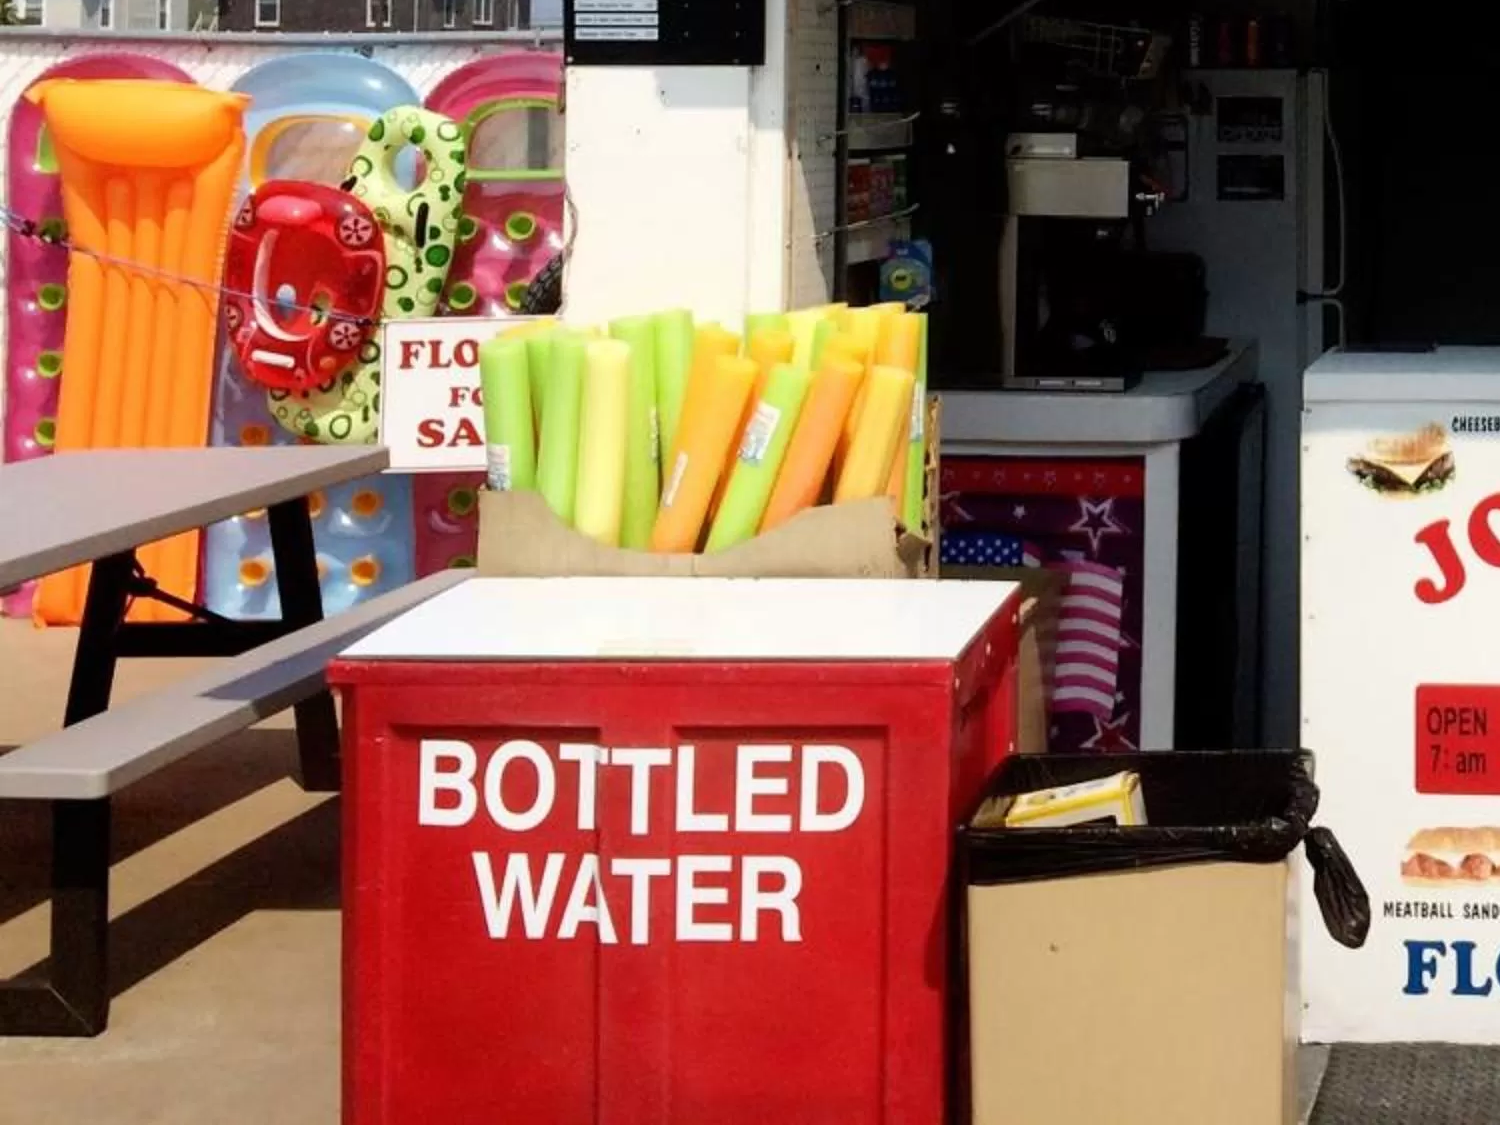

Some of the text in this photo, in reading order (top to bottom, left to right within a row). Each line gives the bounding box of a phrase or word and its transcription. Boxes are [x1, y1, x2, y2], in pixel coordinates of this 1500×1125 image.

[399, 338, 480, 370] FLO
[416, 417, 485, 448] SA
[1426, 706, 1488, 736] OPEN
[417, 739, 866, 836] BOTTLED
[472, 850, 803, 945] WATER
[1383, 901, 1455, 919] MEATBALL
